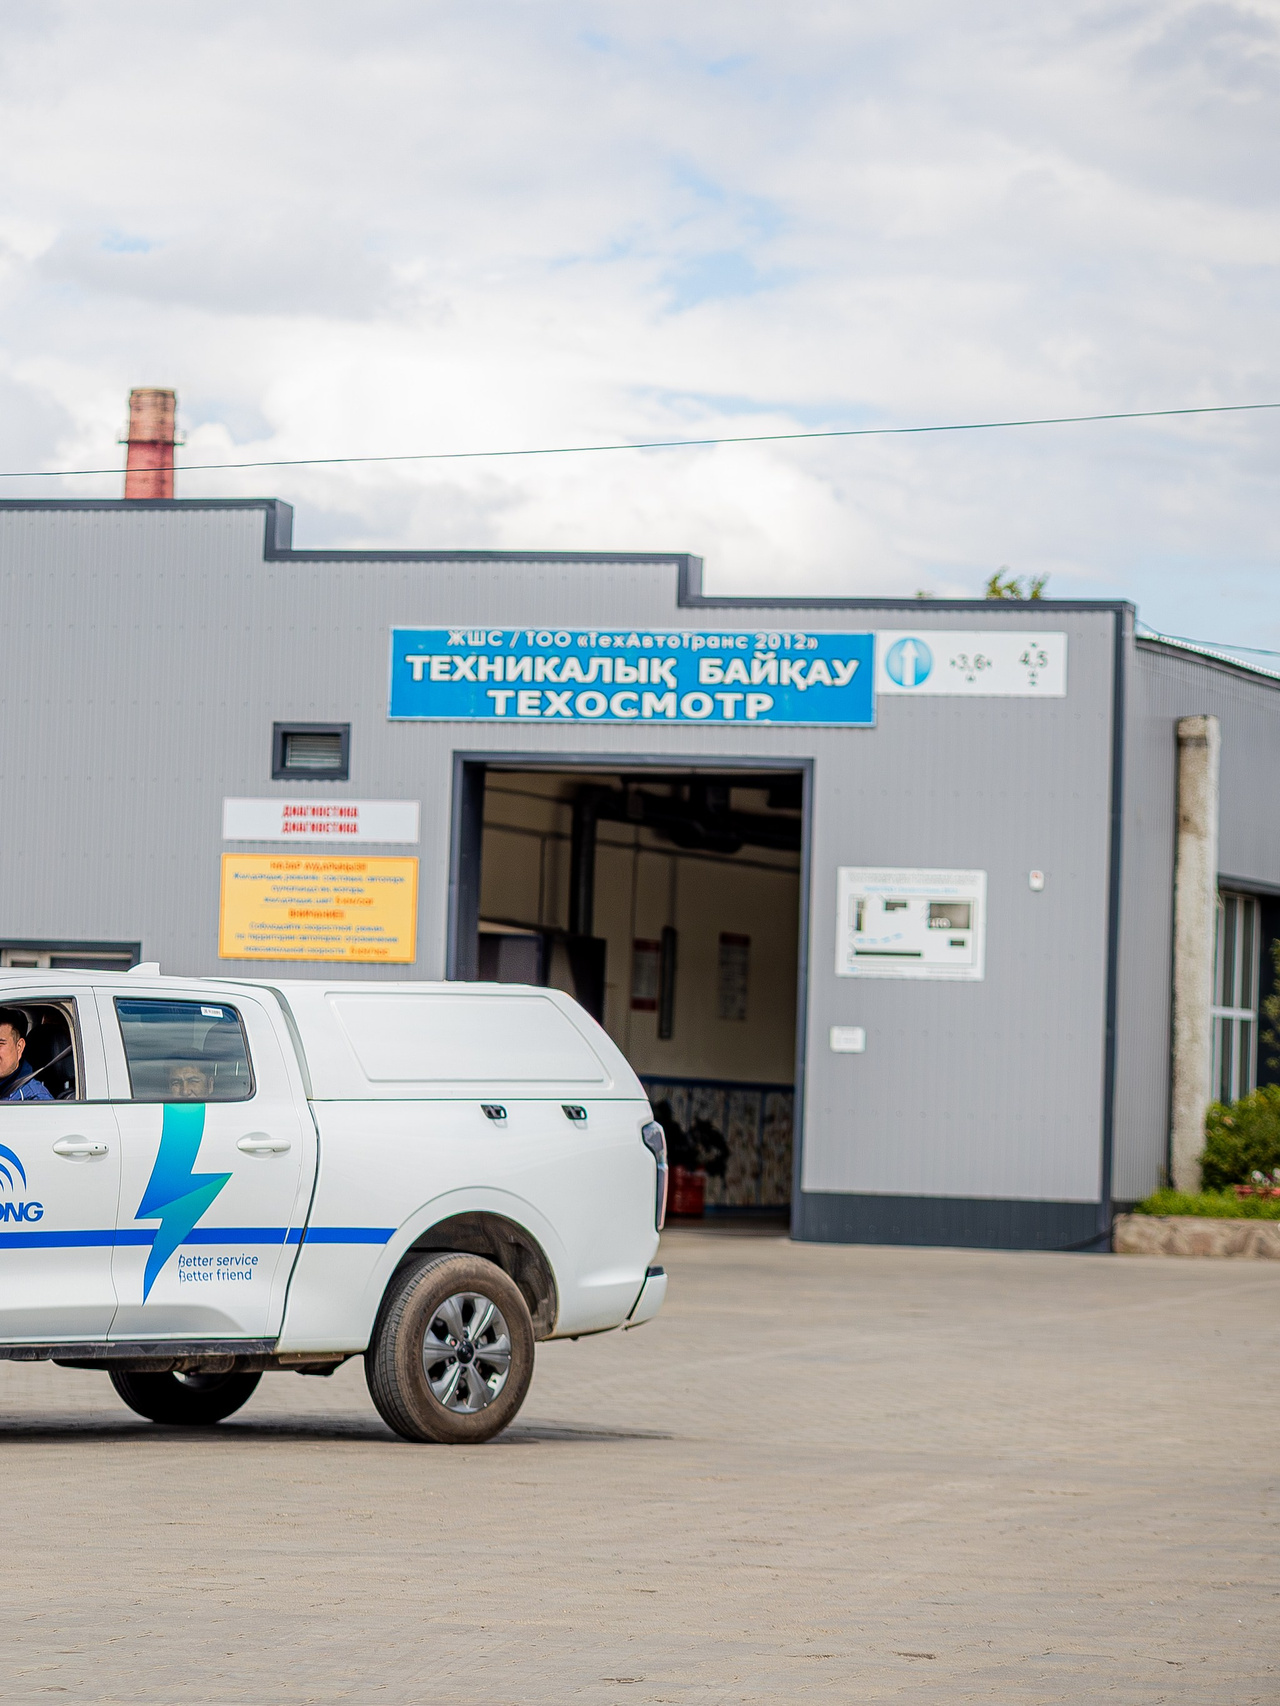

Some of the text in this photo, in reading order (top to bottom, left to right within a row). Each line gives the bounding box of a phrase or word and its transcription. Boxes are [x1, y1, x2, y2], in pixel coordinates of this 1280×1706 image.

[447, 630, 819, 652] ЖШС / ТОО «ТехАвтоТранс 2012»
[405, 651, 860, 691] ТЕХНИКАЛЫҚ БАЙҚАУ
[486, 689, 775, 719] ТЕХОСМОТР
[283, 804, 358, 818] ДИАГНОСТИКА
[282, 820, 357, 834] ДИАГНОСТИКА
[178, 1253, 259, 1268] Better service
[178, 1268, 252, 1283] Better friend
